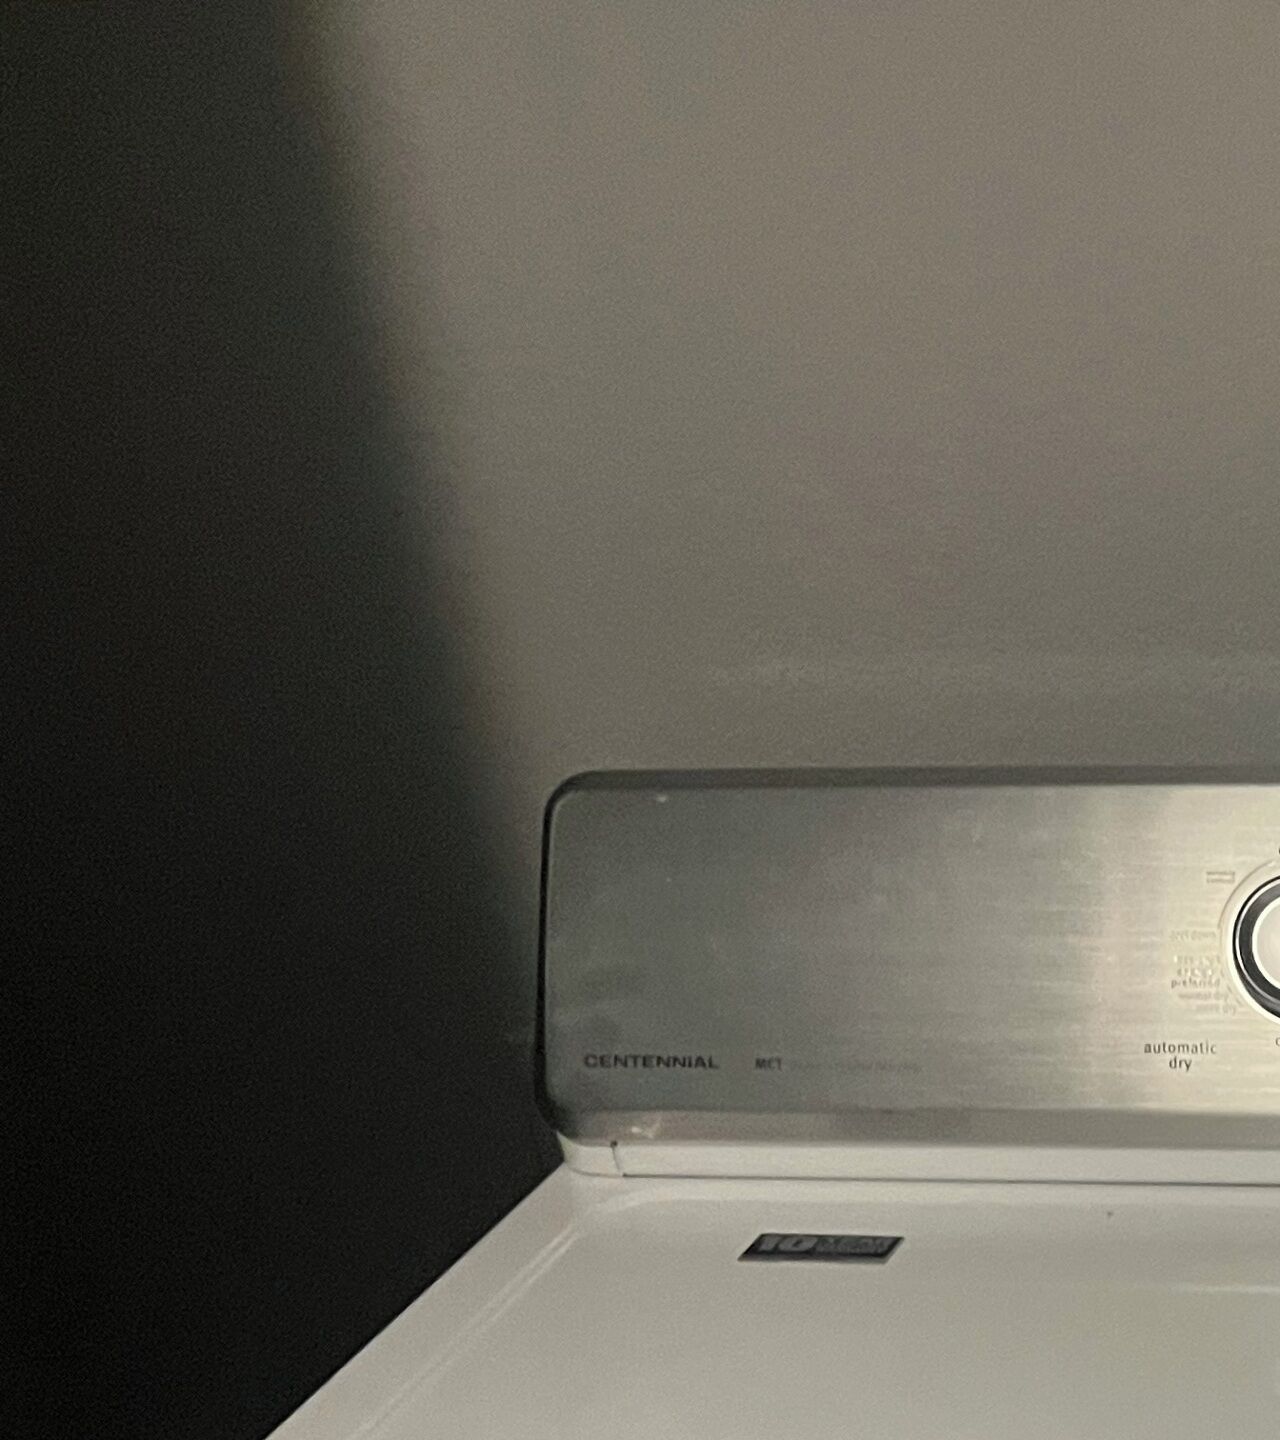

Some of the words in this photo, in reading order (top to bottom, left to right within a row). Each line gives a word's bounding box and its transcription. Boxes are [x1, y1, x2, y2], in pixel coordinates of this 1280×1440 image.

[1143, 1040, 1217, 1054] automatic
[585, 1054, 719, 1069] CENTENNIAL
[1168, 1056, 1192, 1071] dry
